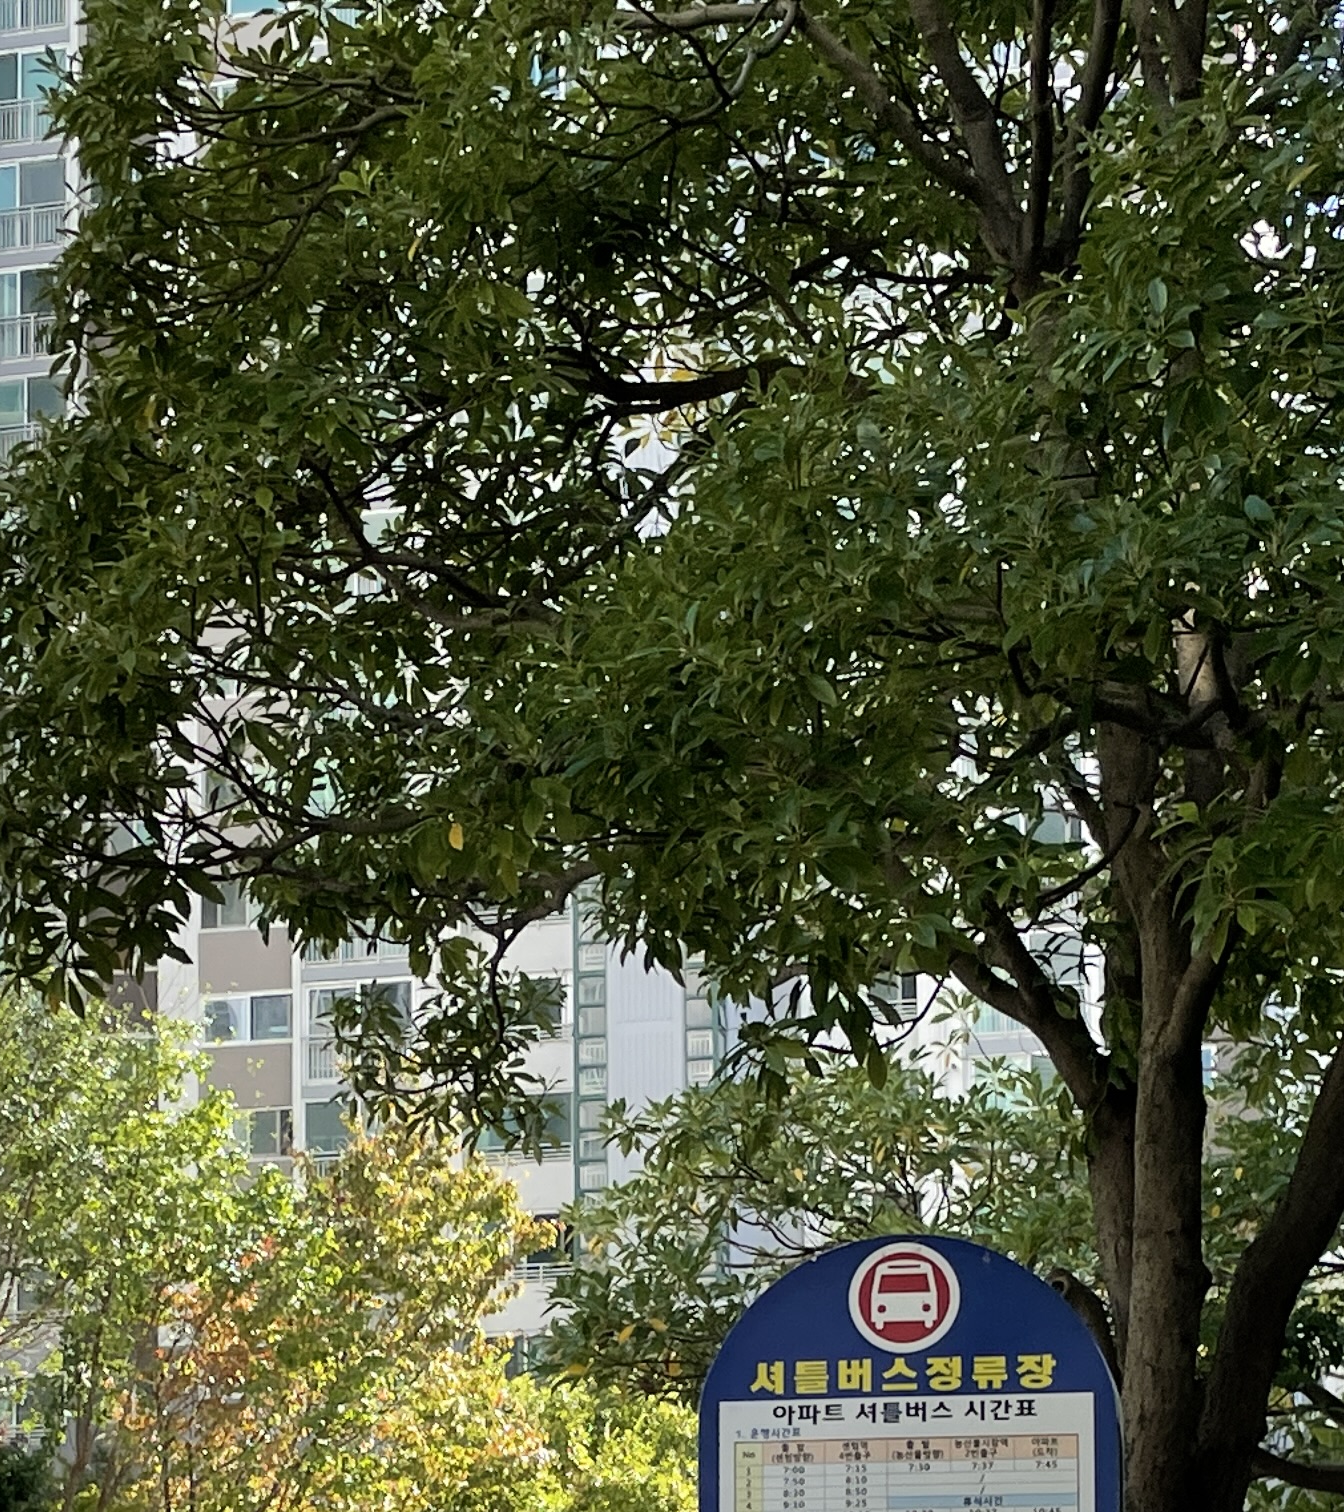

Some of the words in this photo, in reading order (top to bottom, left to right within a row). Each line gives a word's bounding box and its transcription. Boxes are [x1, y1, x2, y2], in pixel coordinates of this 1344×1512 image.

[750, 1352, 1057, 1395] 셔틀버스정류장
[772, 1404, 845, 1425] 아파트
[855, 1402, 954, 1424] 셔틀버스
[965, 1399, 1037, 1419] 시간표
[751, 1428, 800, 1439] 운행시간표
